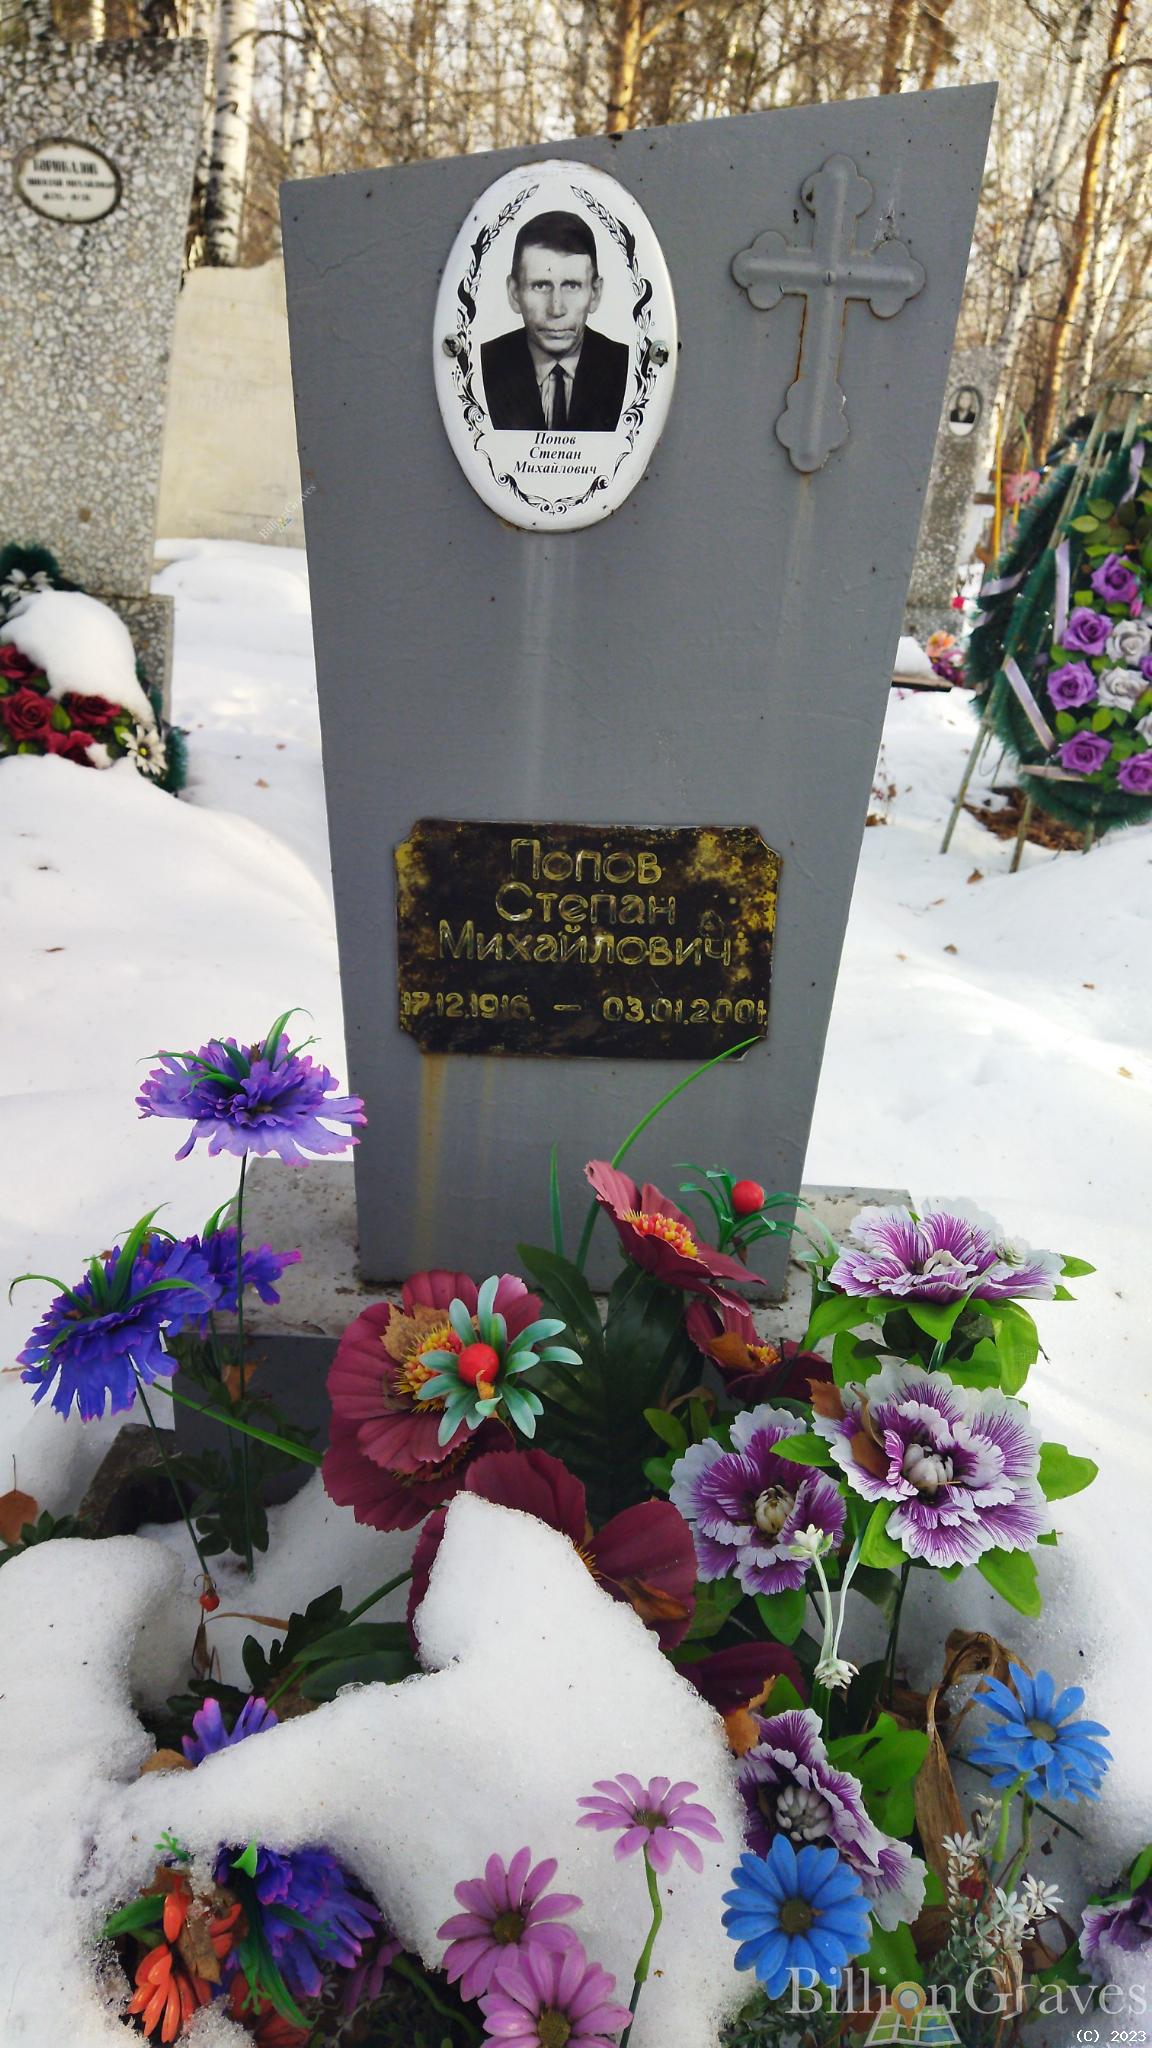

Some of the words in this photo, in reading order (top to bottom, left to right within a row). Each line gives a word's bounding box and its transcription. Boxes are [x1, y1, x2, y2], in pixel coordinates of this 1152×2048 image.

[534, 432, 576, 445] Попов
[529, 446, 581, 460] Степан
[513, 461, 597, 474] Михайлович
[510, 838, 662, 885] Попов
[495, 882, 677, 925] Степан
[438, 919, 732, 967] Михайлович
